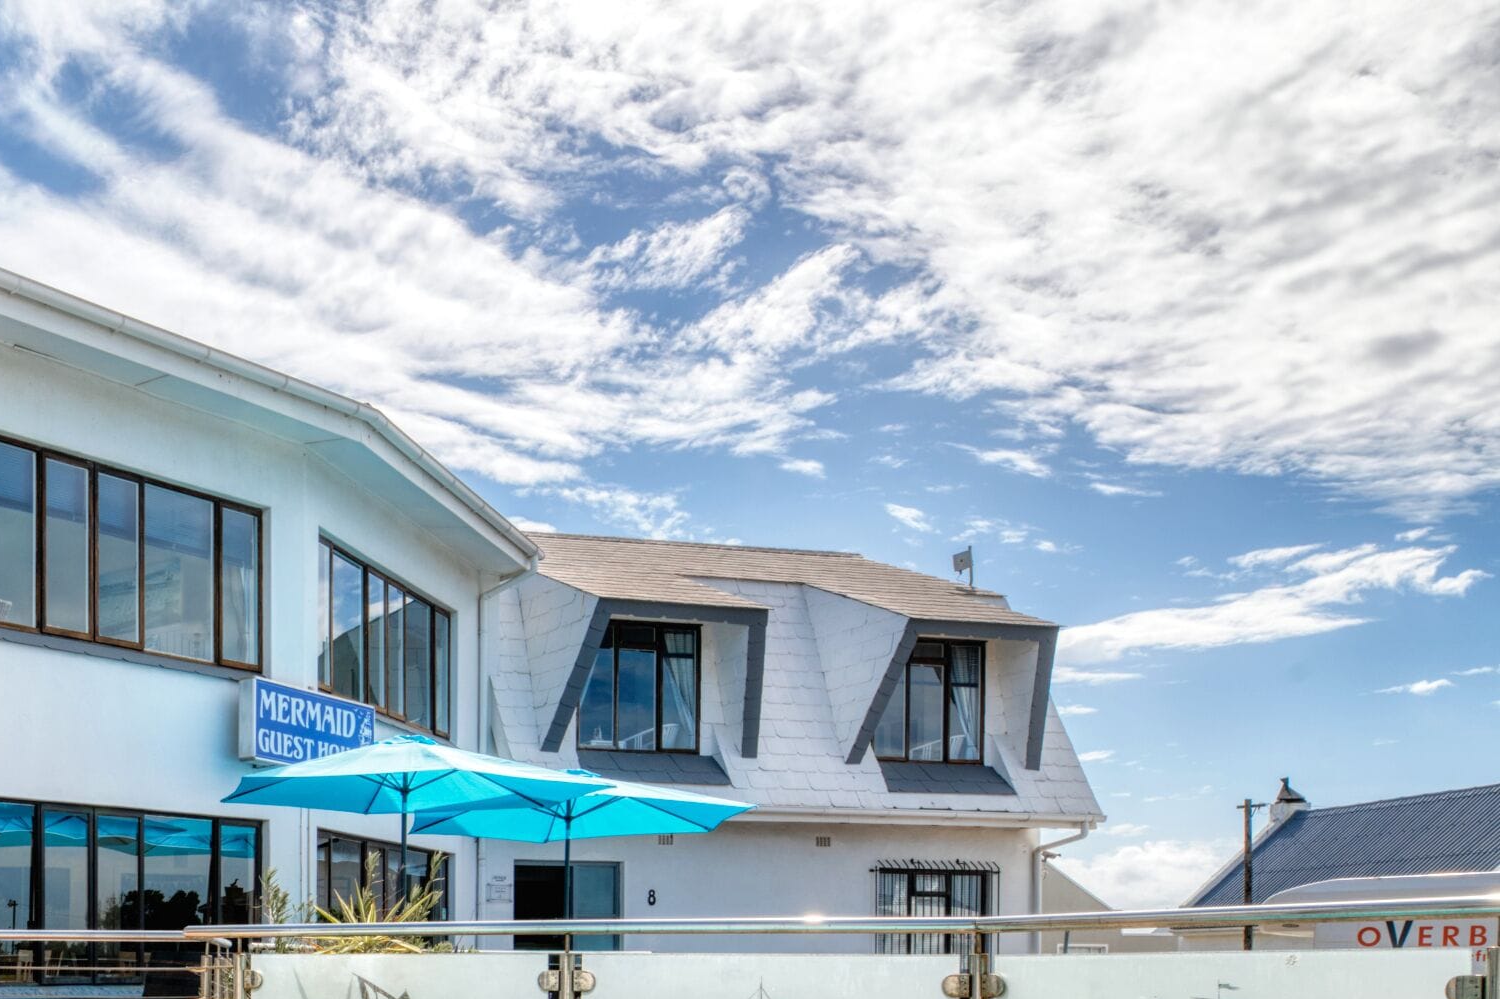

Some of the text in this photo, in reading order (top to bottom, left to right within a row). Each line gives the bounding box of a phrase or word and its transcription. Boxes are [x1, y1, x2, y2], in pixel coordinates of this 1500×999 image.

[260, 689, 356, 738] MERMAID
[258, 728, 315, 760] GUEST
[647, 889, 656, 906] 8
